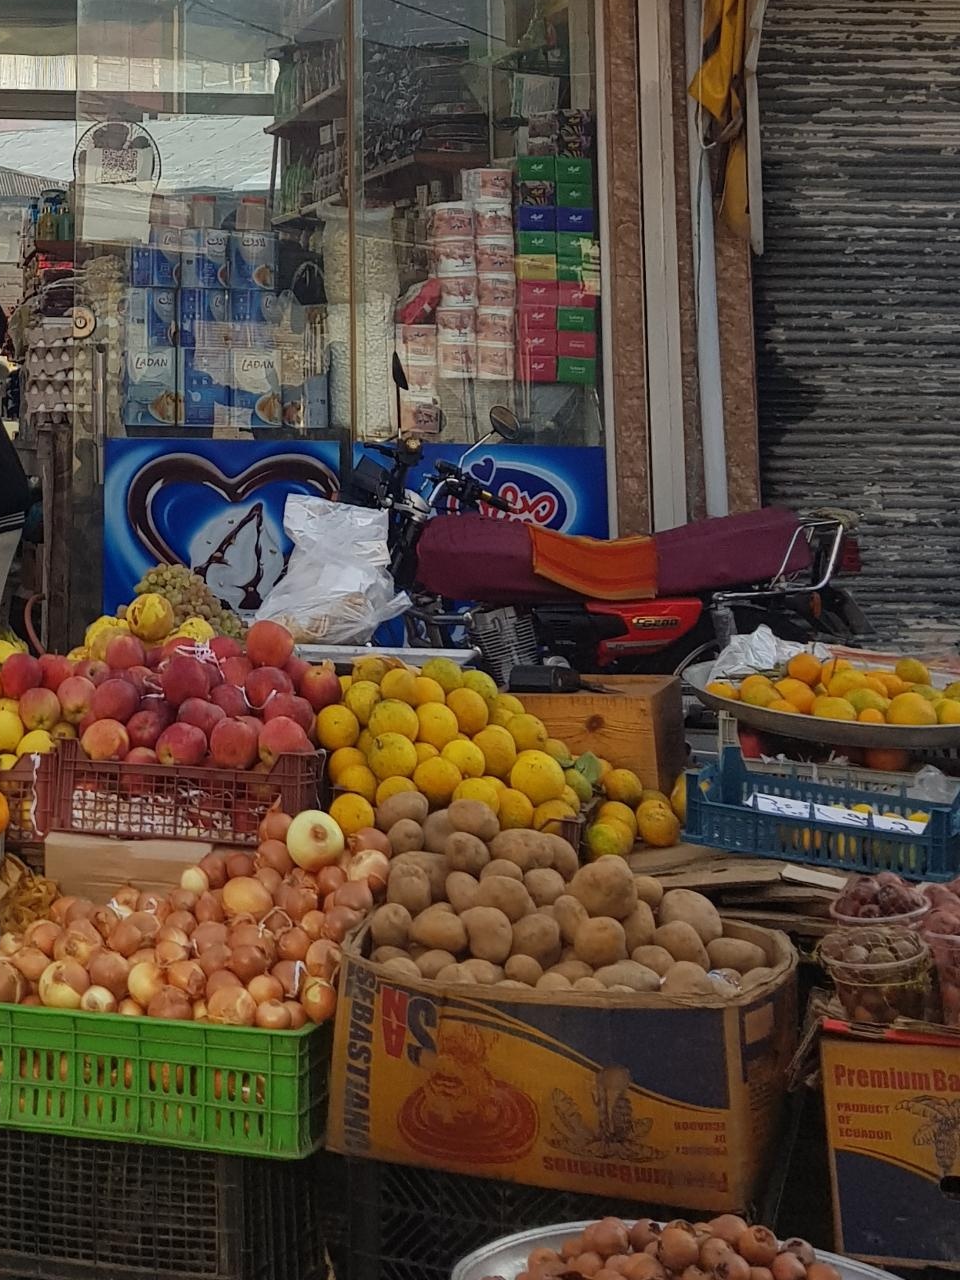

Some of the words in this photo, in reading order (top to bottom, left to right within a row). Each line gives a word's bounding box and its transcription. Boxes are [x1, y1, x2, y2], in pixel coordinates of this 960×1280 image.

[135, 357, 168, 370] LADAN
[241, 359, 275, 372] LADAN
[833, 1064, 931, 1092] Premium
[836, 1102, 890, 1114] PRODUCT
[837, 1115, 851, 1125] OF
